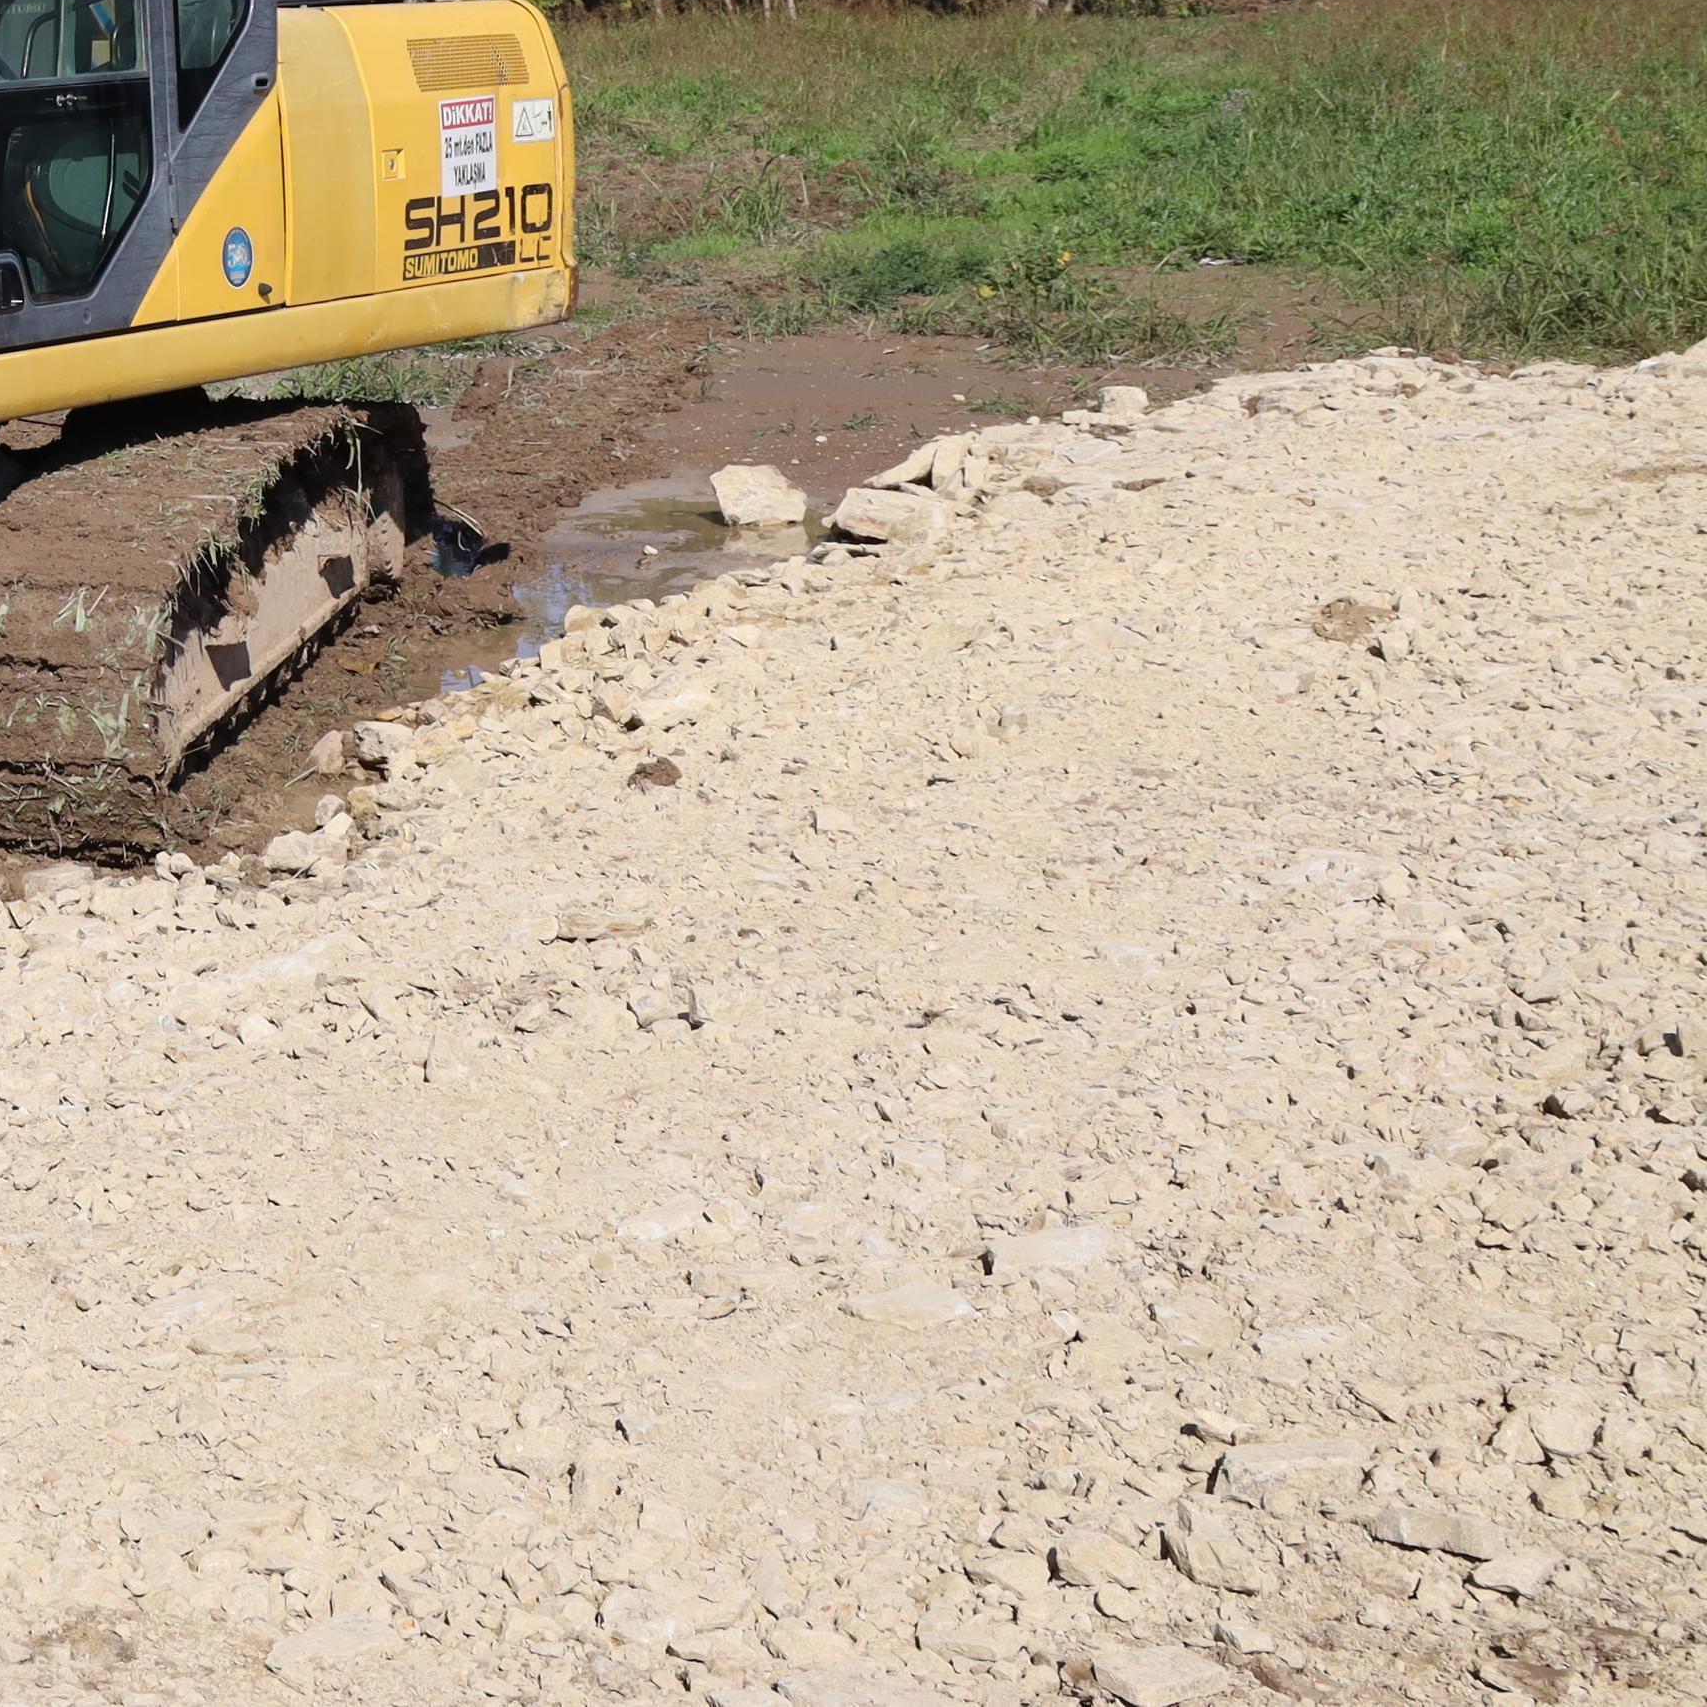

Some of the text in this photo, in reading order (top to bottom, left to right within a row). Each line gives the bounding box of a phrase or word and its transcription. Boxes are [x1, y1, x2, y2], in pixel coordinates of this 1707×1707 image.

[475, 131, 493, 154] FAZLA
[404, 183, 553, 251] SH210
[405, 248, 479, 278] SUMITOMO
